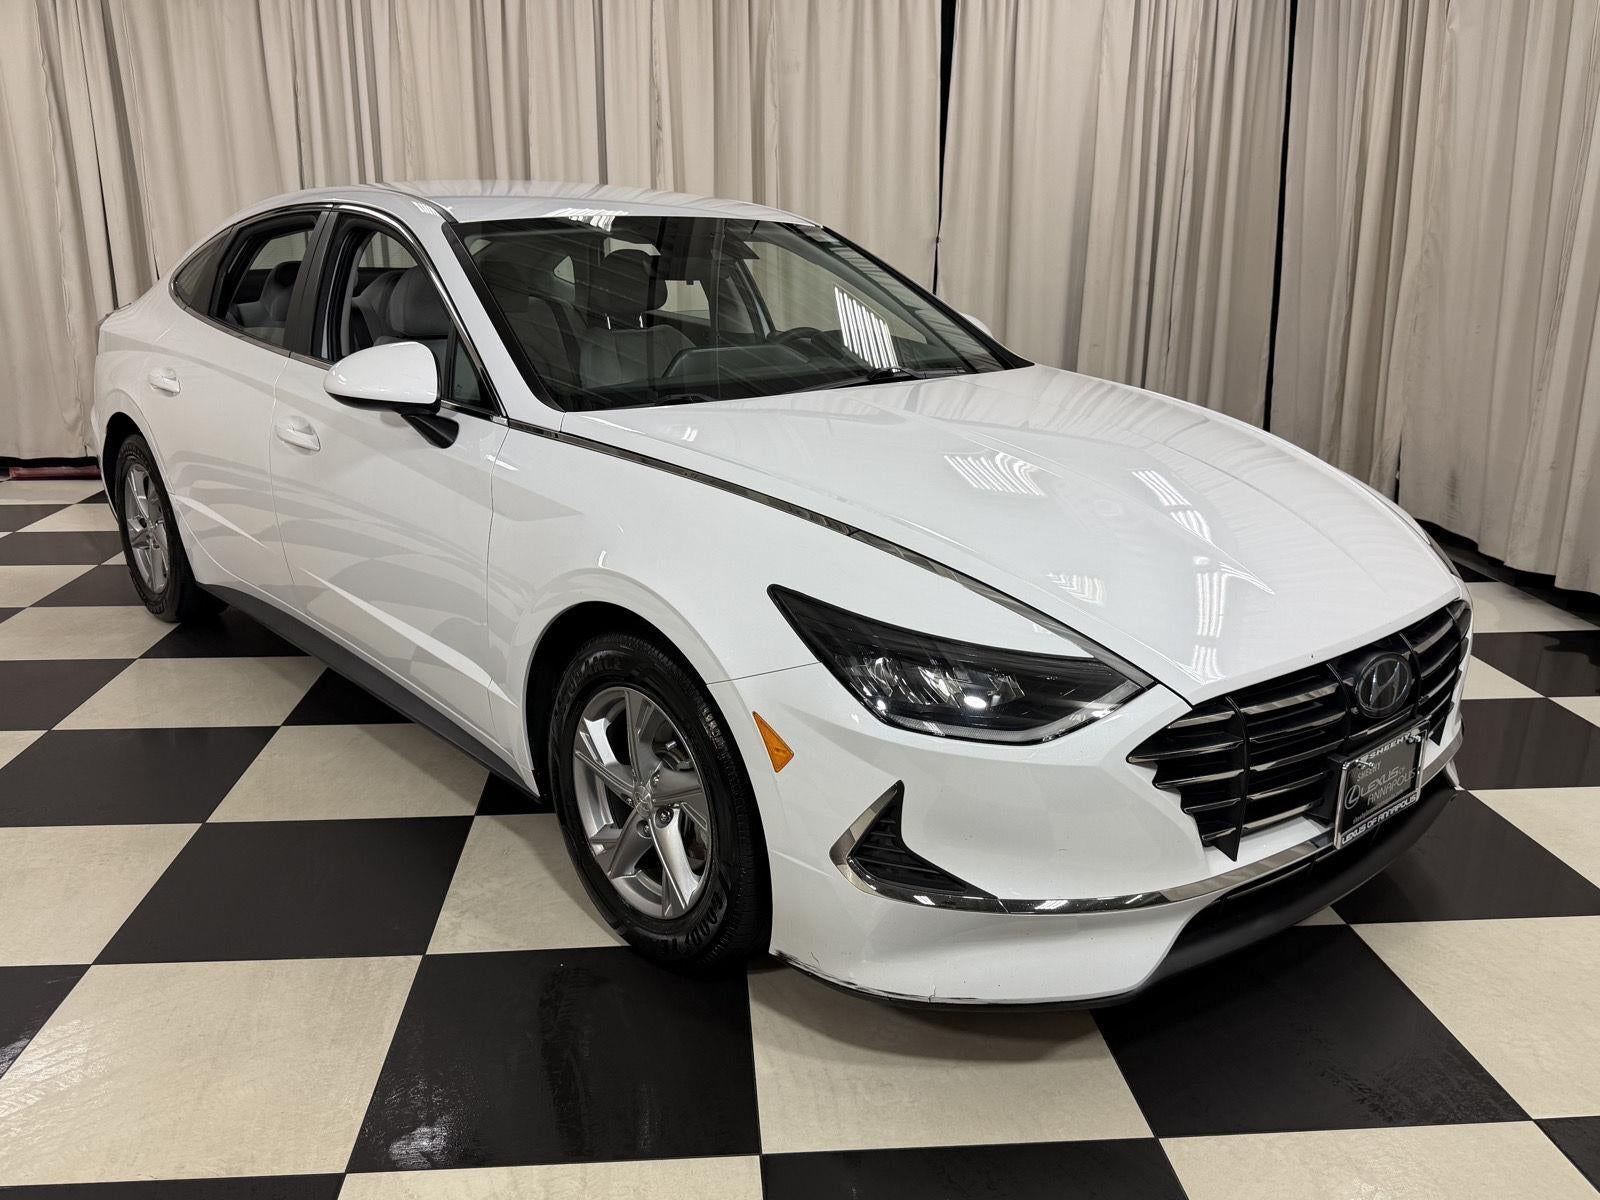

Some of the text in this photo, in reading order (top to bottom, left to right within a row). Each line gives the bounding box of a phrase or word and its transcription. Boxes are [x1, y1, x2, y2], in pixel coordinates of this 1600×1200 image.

[1361, 766, 1399, 798] LEXUS
[1367, 768, 1416, 806] ANNAPOLIS
[1341, 823, 1367, 845] LEXUS
[1366, 816, 1378, 829] OF
[1377, 794, 1416, 823] ANNAPOLIS
